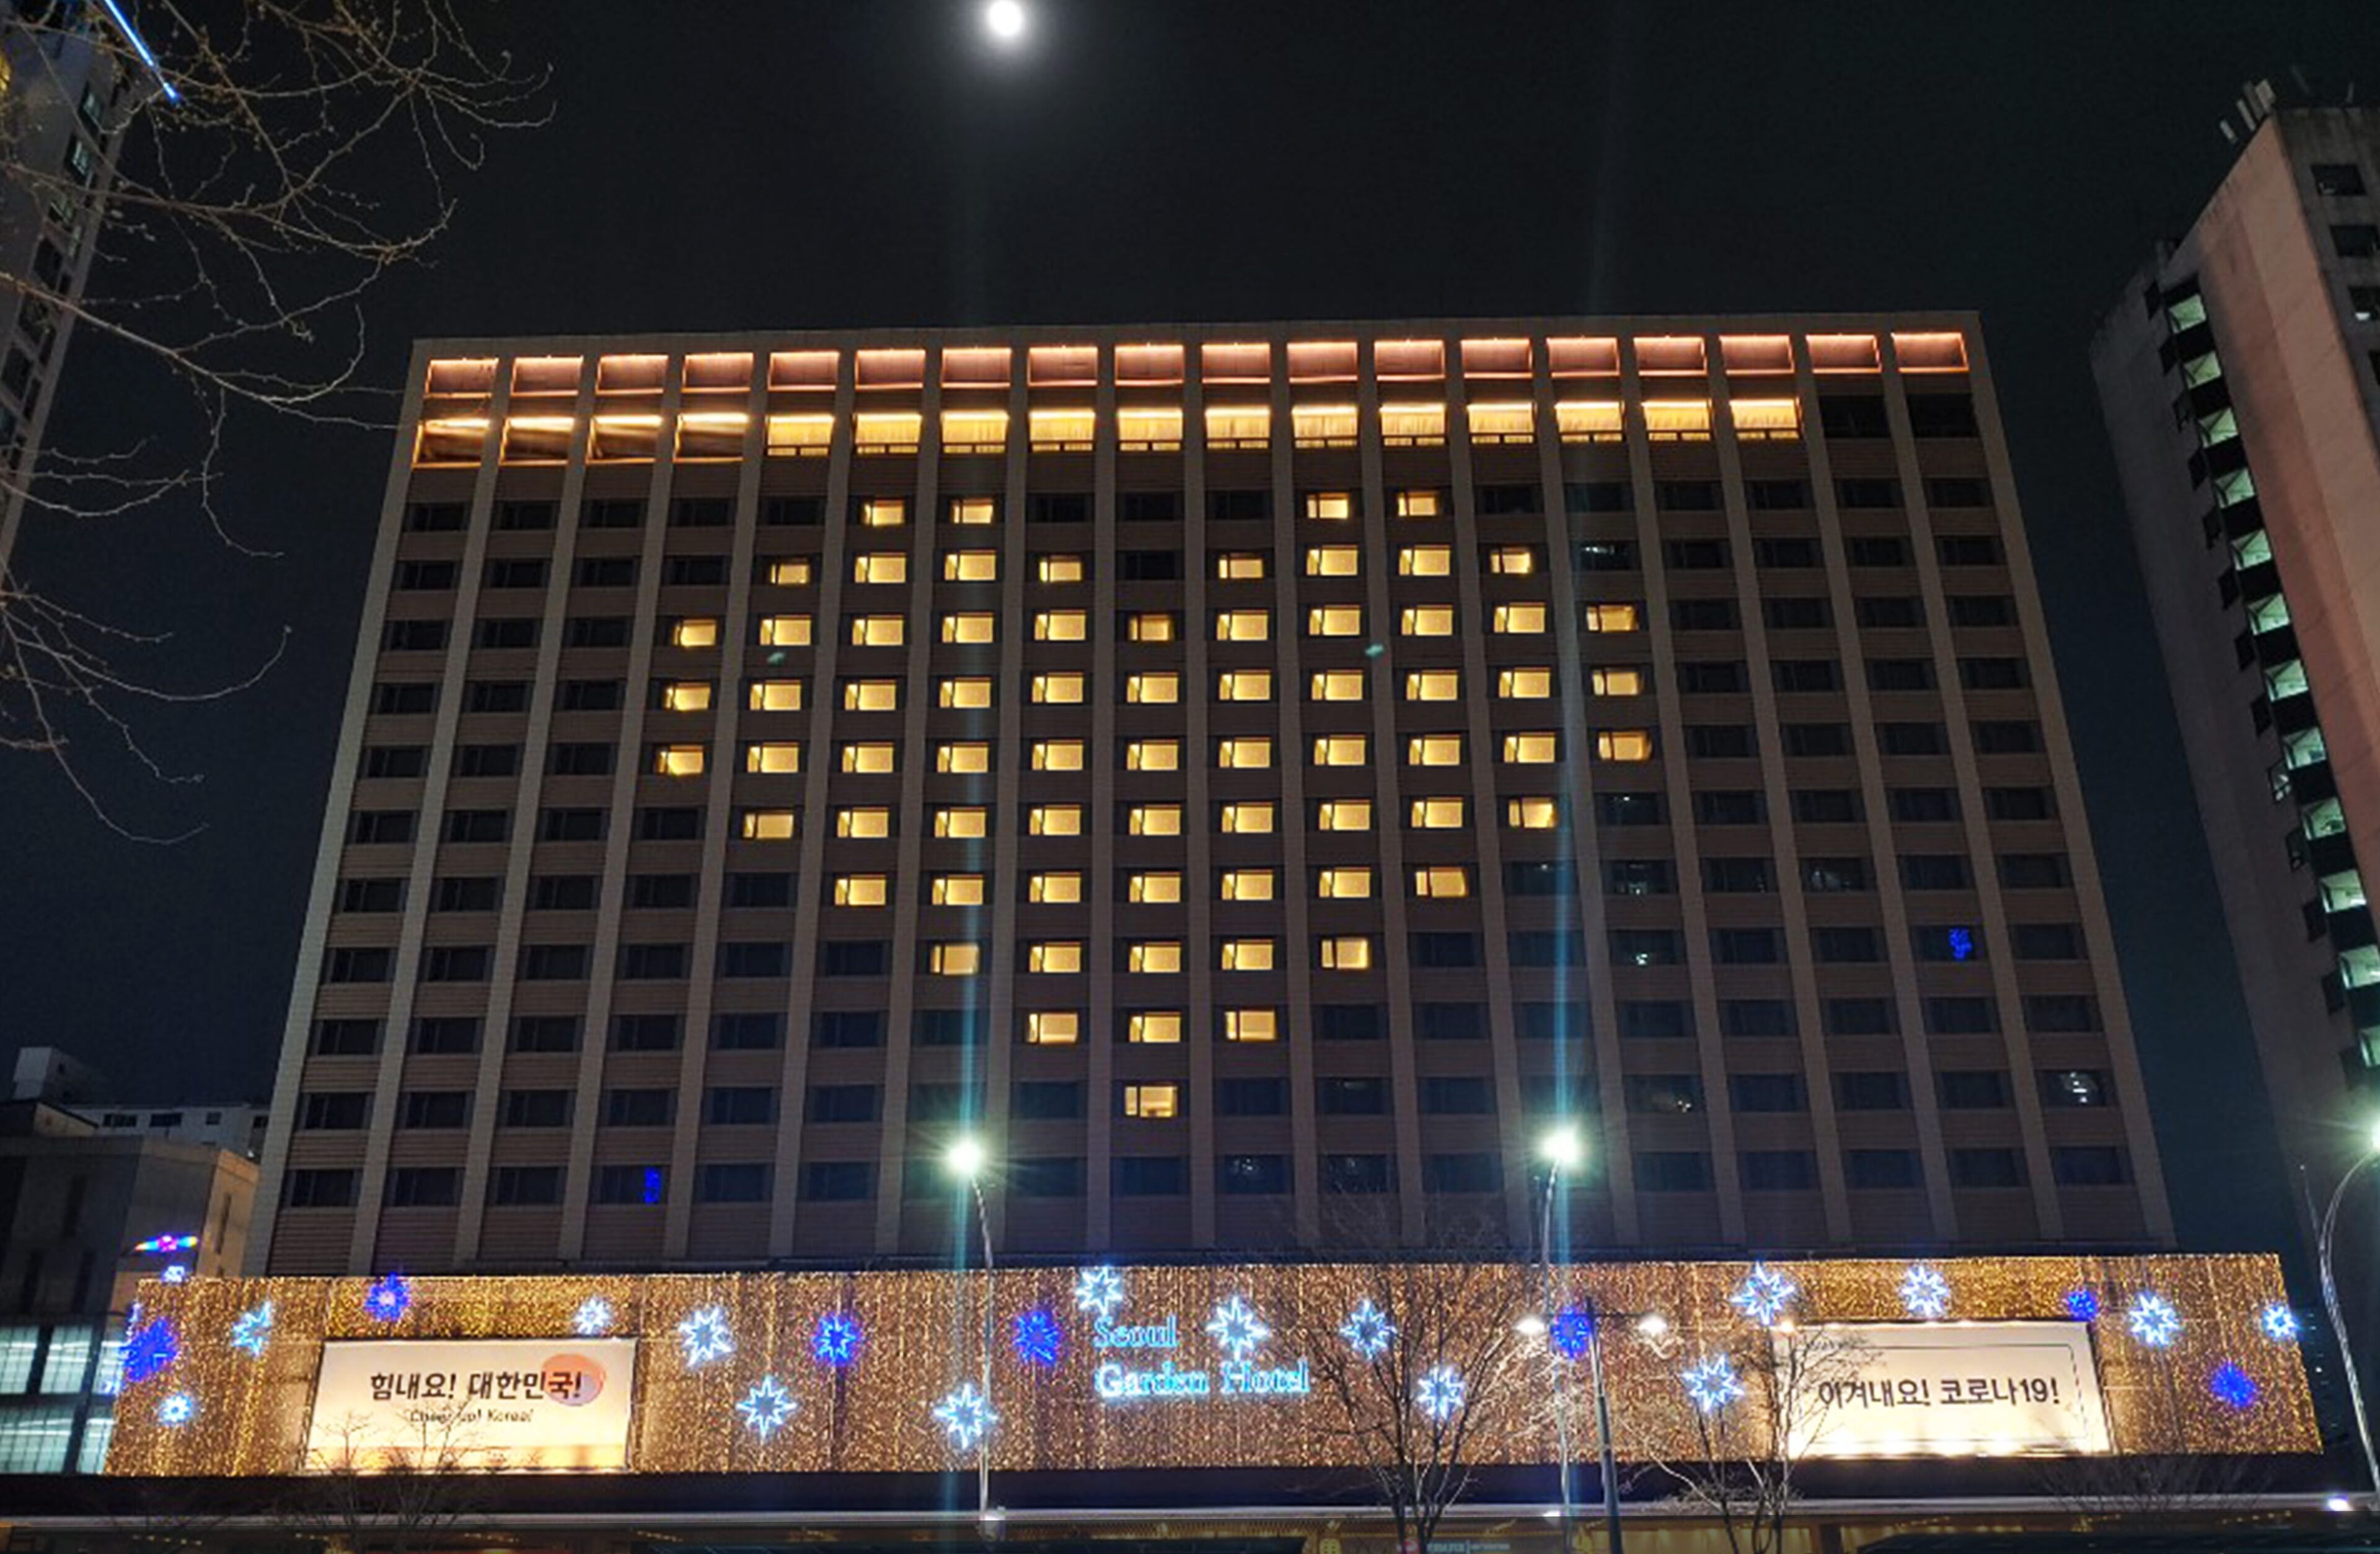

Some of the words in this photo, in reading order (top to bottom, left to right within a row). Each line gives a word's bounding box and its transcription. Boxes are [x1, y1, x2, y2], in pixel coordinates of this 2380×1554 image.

[1093, 1315, 1179, 1348] Seoul
[371, 1371, 456, 1400] 힘내요!
[468, 1371, 582, 1401] 대한민국!
[1094, 1362, 1210, 1397] Garden
[1220, 1359, 1310, 1393] Hotel
[1818, 1377, 1931, 1408] 이겨내요!
[1940, 1377, 2060, 1406] 코로나19!
